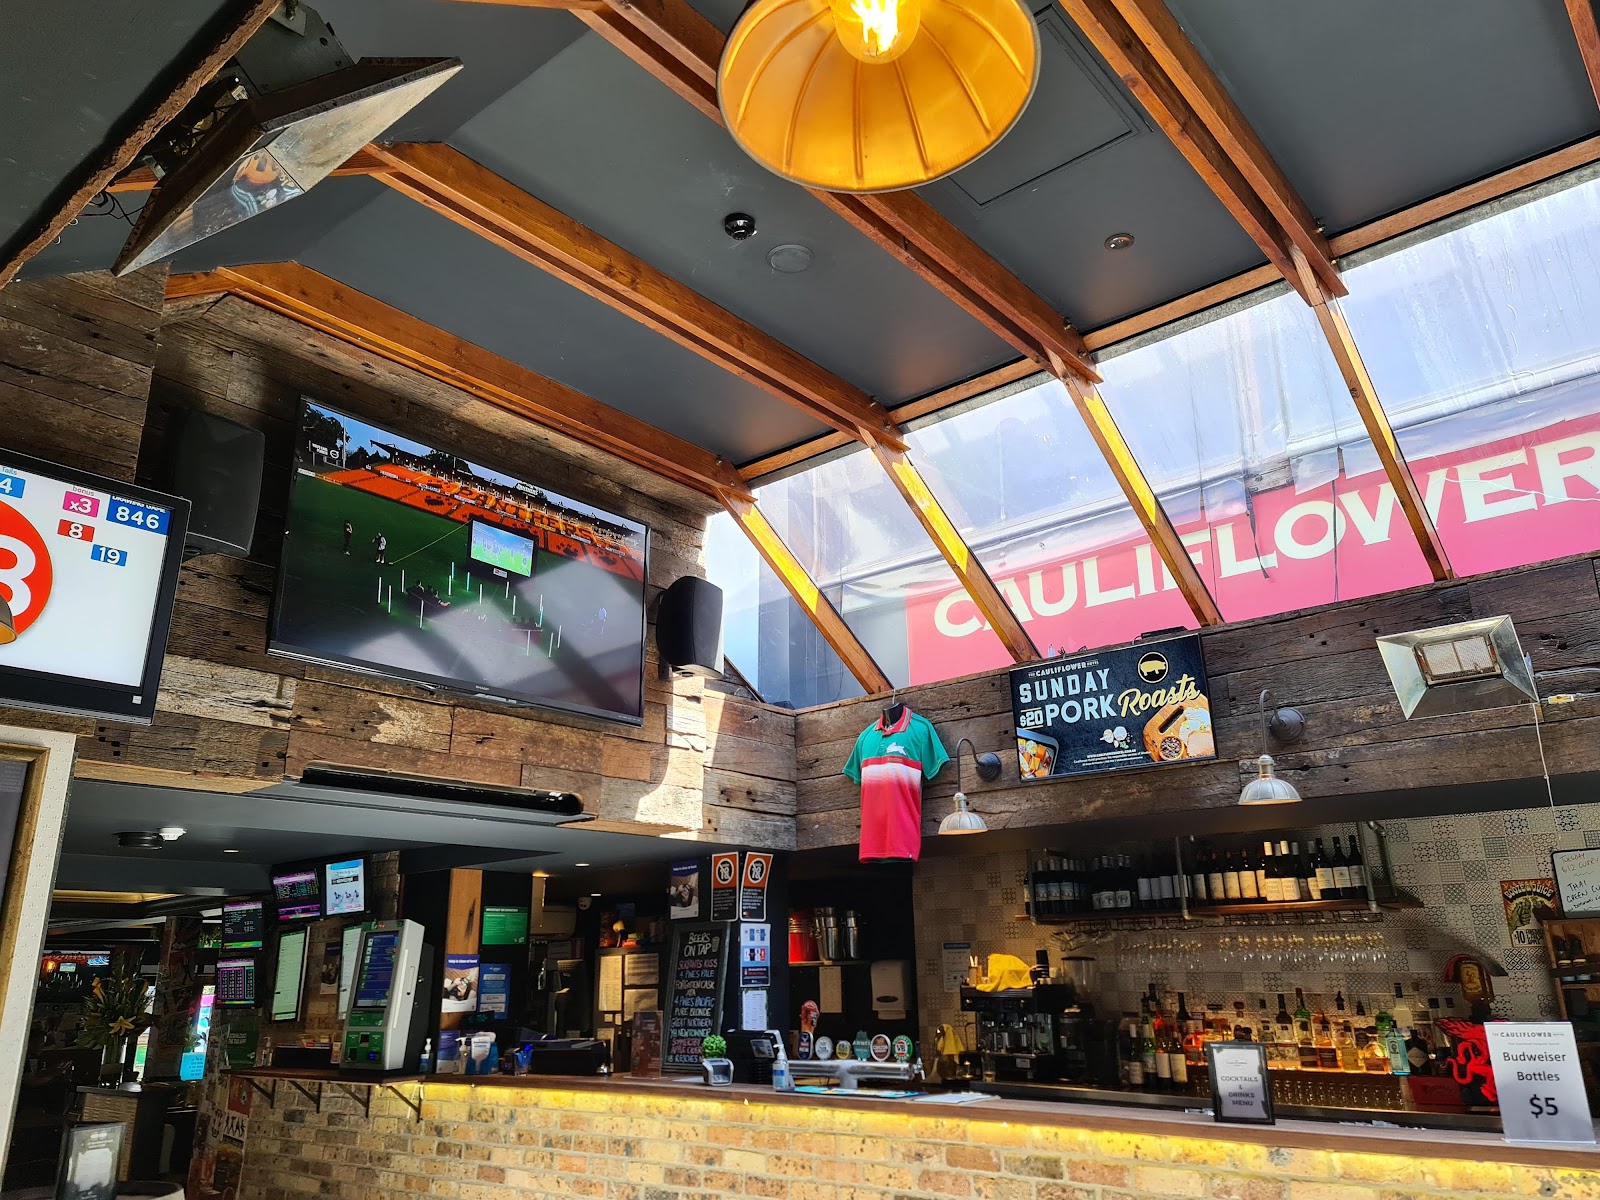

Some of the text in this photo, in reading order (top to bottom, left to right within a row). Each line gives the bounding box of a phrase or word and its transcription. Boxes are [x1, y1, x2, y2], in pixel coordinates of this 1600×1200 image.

[72, 485, 94, 496] bonus
[69, 497, 92, 514] x3
[115, 506, 159, 529] 846
[69, 523, 83, 539] 8
[933, 430, 1600, 638] CAULIFLOWER
[99, 546, 120, 564] 19
[1035, 661, 1087, 677] CAULIFLOWER
[1019, 668, 1110, 704] SUNDAY
[1020, 673, 1201, 727] $20 PORK Roasts
[1532, 884, 1554, 898] JUICE
[1567, 880, 1587, 891] THAI
[689, 932, 710, 944] BEERS
[684, 942, 712, 957] ON TAP
[704, 959, 718, 968] KISS
[690, 1007, 712, 1016] BLONDE
[1502, 1051, 1566, 1061] Budweiser
[1517, 1071, 1560, 1081] Bottles
[1529, 1094, 1559, 1118] $5
